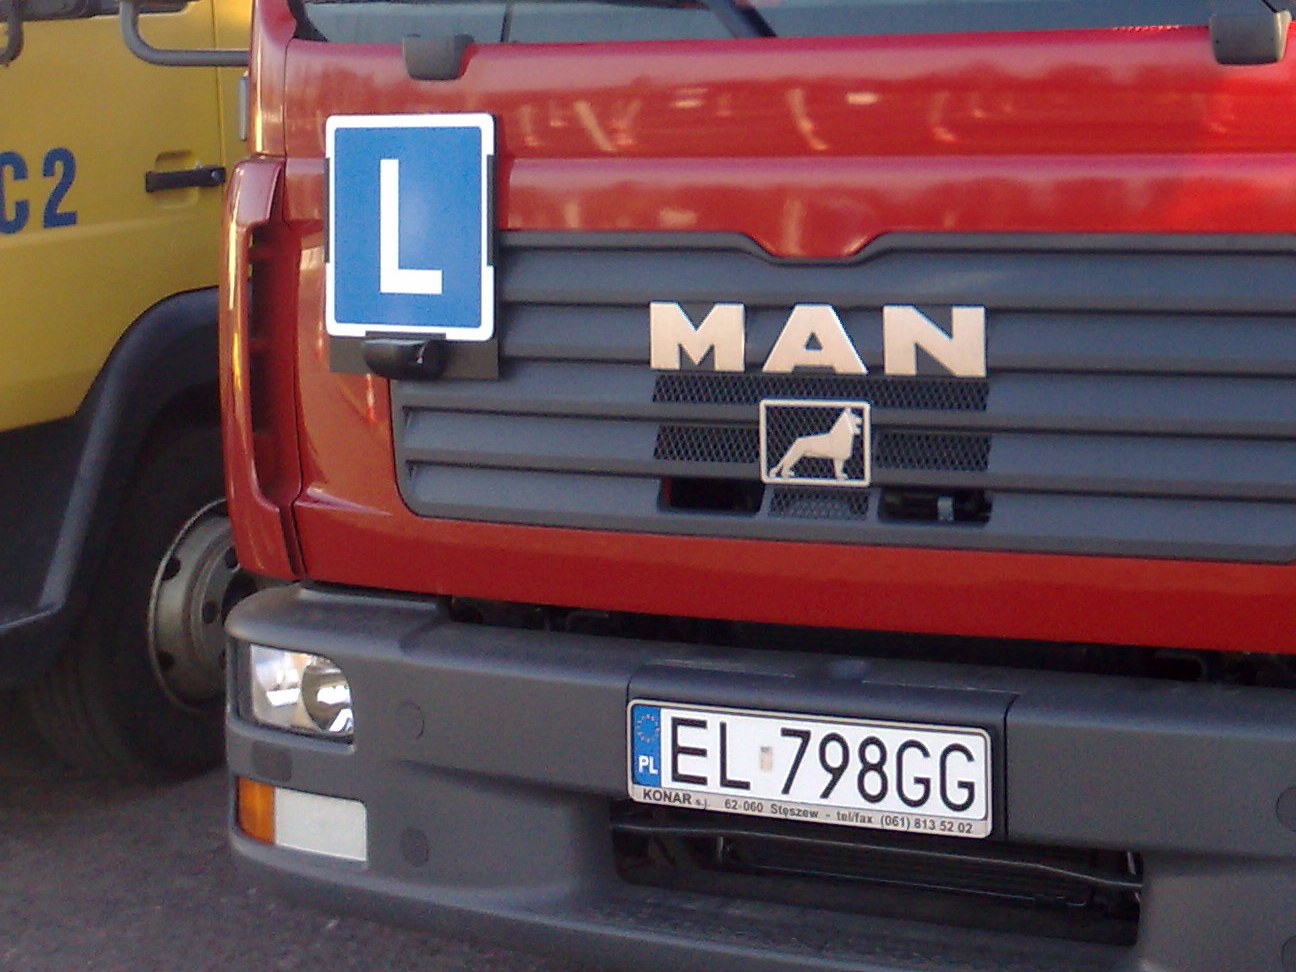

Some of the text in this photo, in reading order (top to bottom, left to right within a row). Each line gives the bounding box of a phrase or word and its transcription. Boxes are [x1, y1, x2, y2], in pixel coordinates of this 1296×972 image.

[379, 158, 443, 294] L
[649, 301, 988, 378] MAN
[638, 754, 659, 775] PL
[671, 716, 976, 812] EL 798GG
[643, 789, 692, 806] KONAR
[880, 815, 911, 830] (061)
[914, 818, 936, 831] 813
[939, 820, 957, 833] 52
[957, 821, 973, 834] 02
